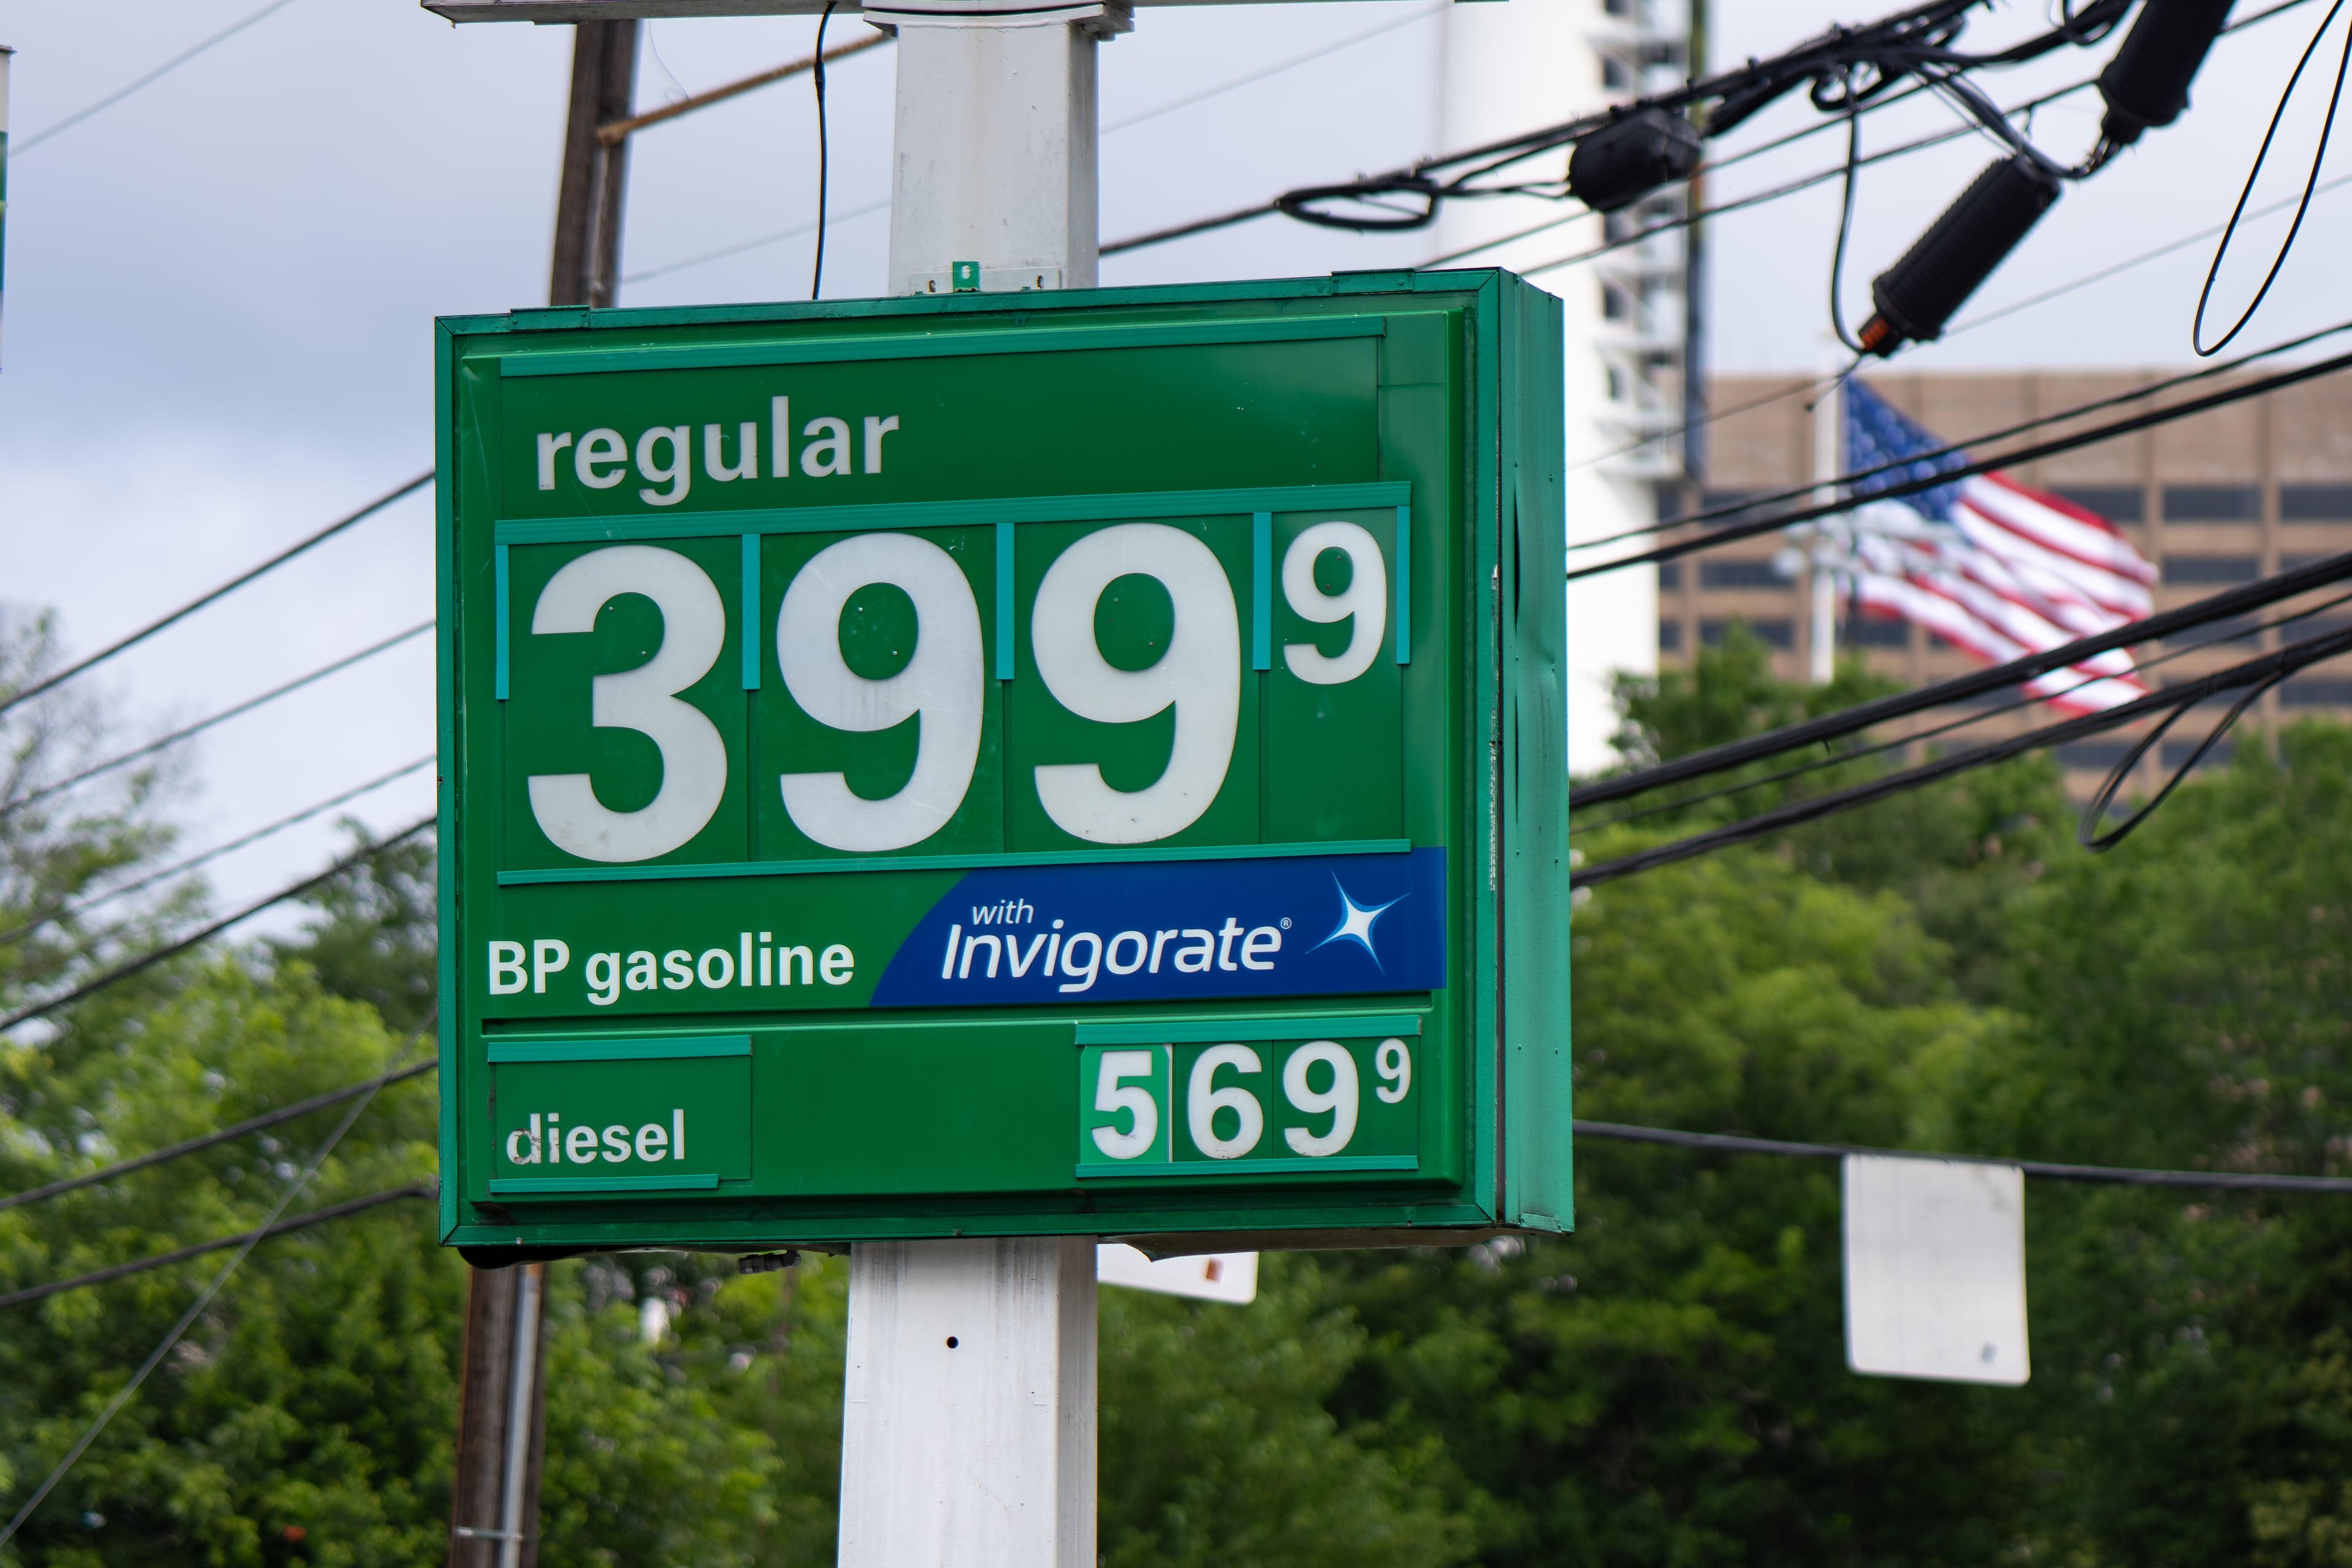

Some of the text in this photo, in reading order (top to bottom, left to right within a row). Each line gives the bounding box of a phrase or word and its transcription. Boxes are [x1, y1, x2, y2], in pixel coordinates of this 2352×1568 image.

[537, 396, 900, 507] regular
[973, 897, 1035, 925] with
[488, 932, 855, 1006] BP gasoline
[506, 1108, 685, 1165] diesel
